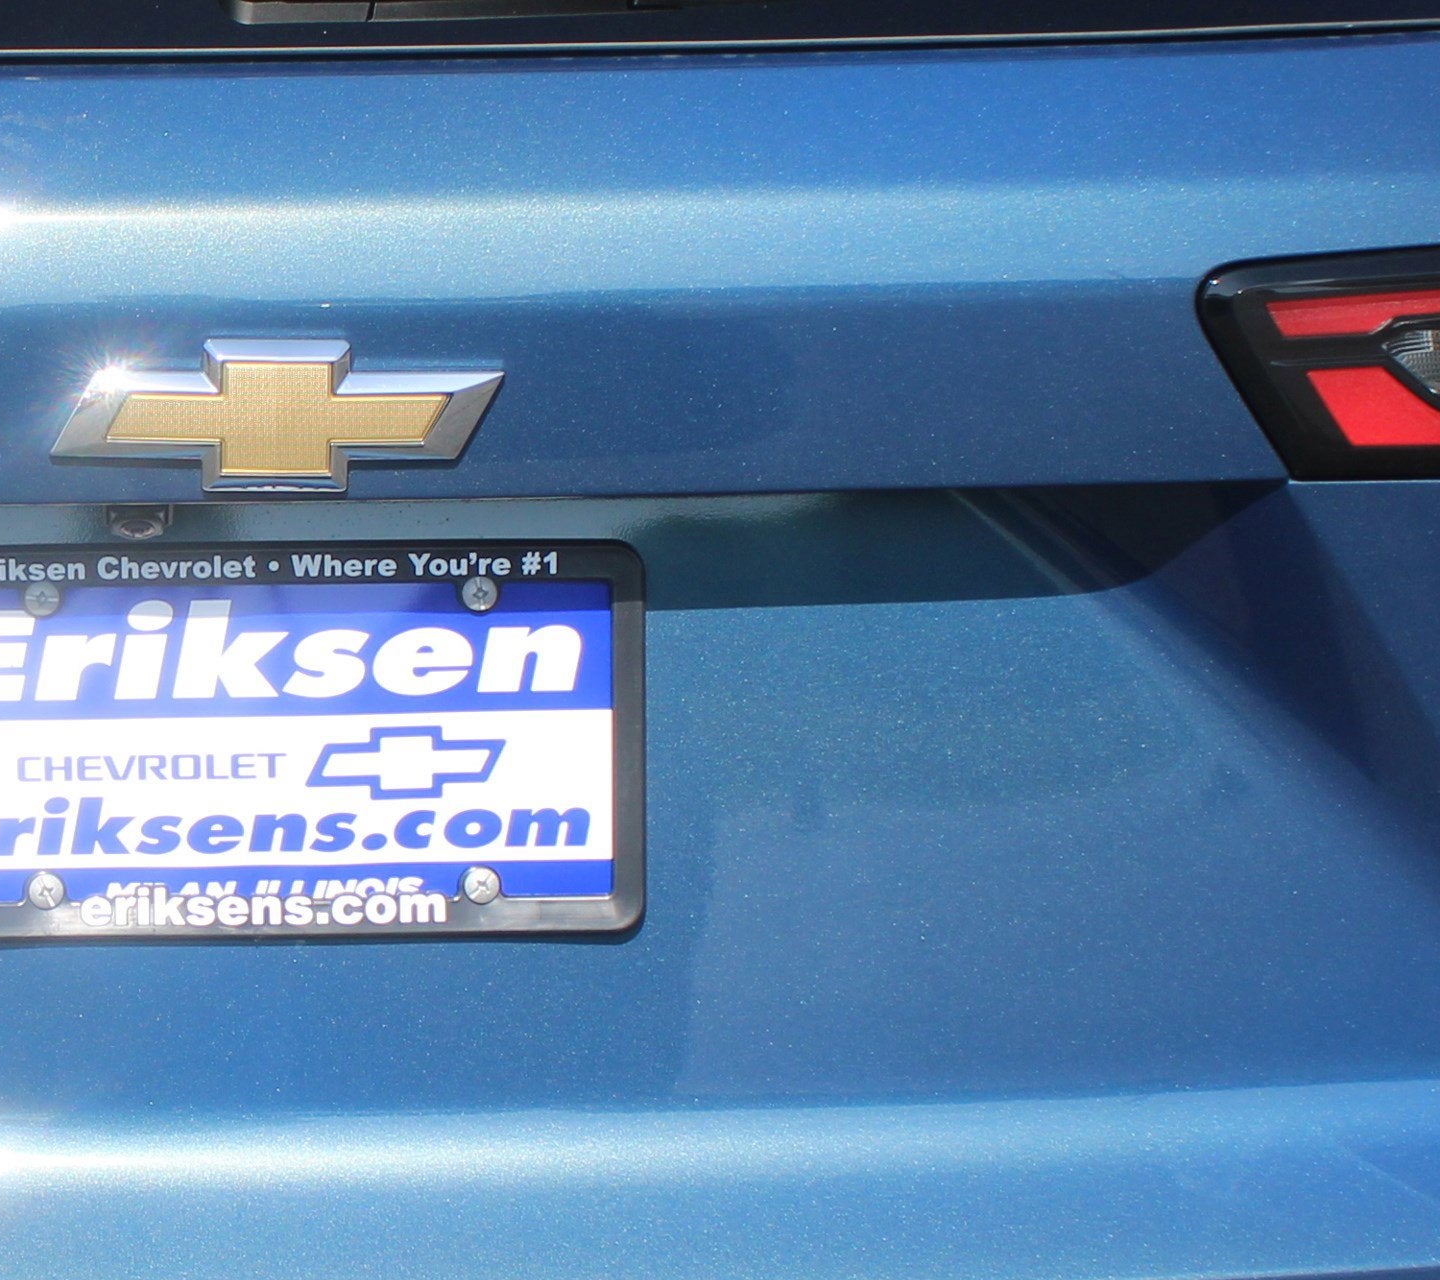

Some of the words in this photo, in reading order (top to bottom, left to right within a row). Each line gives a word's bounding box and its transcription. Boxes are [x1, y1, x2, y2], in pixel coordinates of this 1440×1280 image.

[97, 555, 256, 580] Chevrolet
[291, 553, 398, 578] Where
[408, 551, 512, 576] You're
[521, 551, 559, 575] #1
[16, 752, 287, 783] CHEVROLET
[80, 886, 447, 927] eriksens.com
